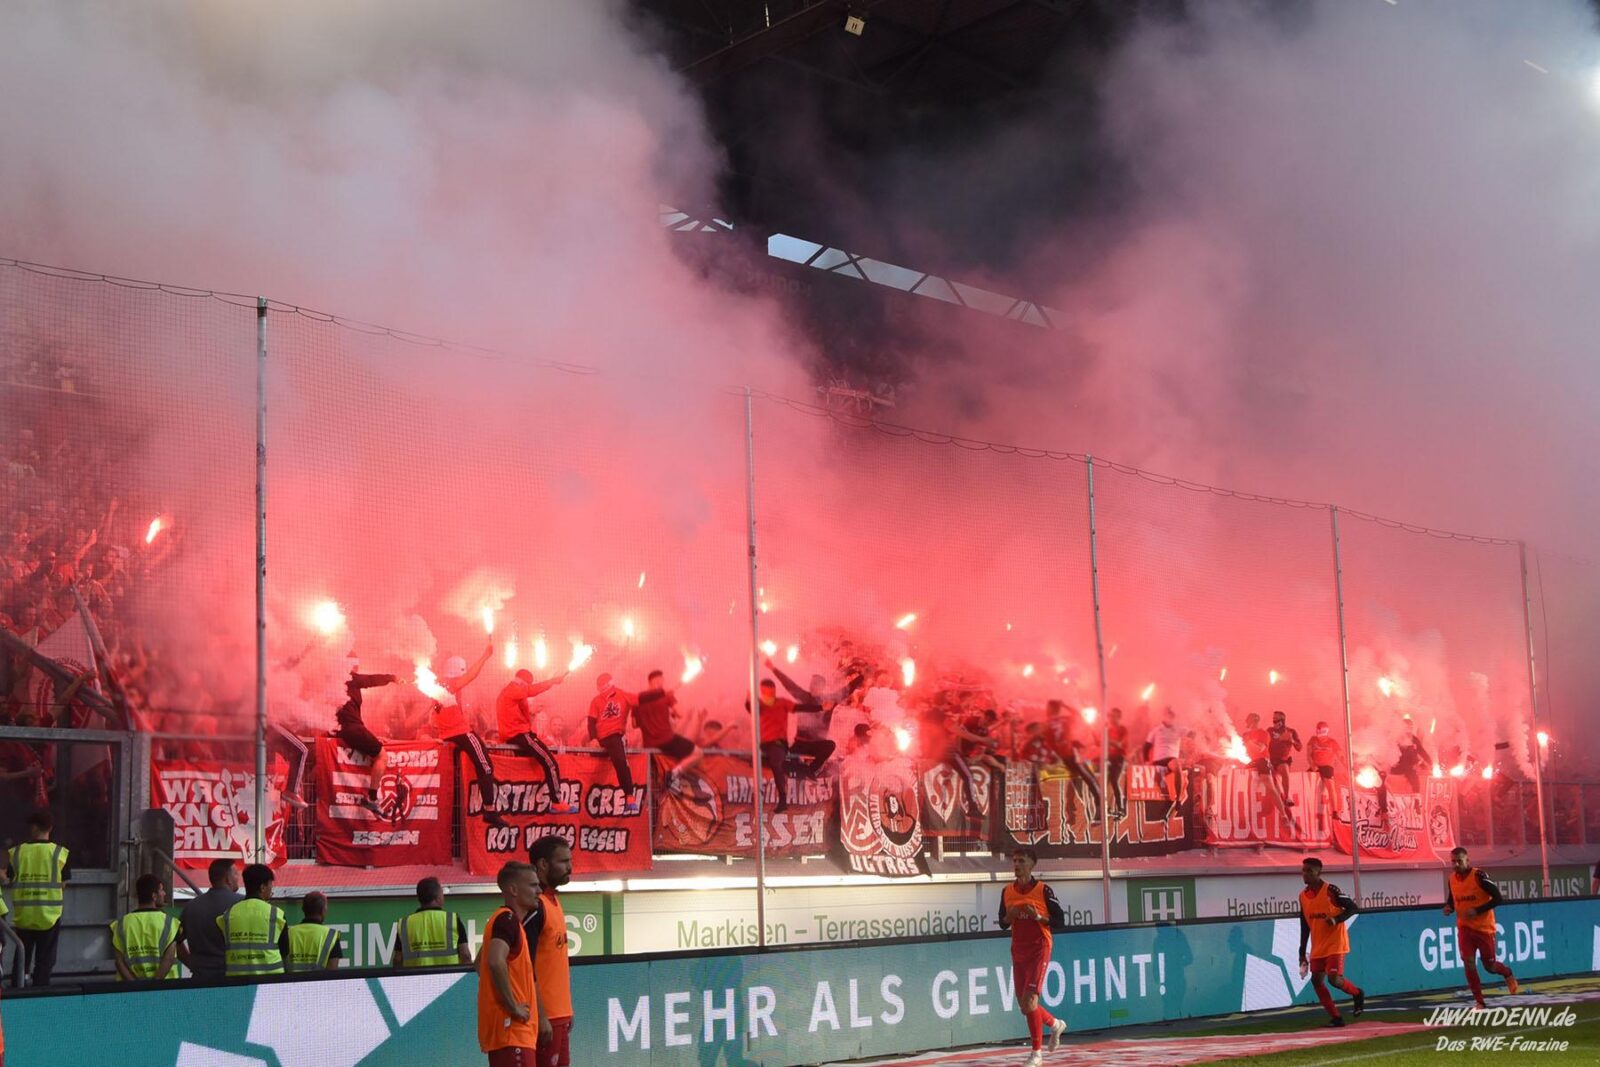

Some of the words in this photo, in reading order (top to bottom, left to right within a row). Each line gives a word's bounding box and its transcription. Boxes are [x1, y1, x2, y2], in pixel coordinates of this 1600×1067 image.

[469, 782, 582, 814] NRTHSDE
[352, 831, 420, 846] ESSEN
[487, 826, 519, 850] ROT
[580, 827, 628, 851] ESSEN
[850, 854, 920, 875] ULTRAS
[1494, 880, 1524, 900] EIM
[1227, 895, 1299, 917] Haustüren
[677, 919, 787, 947] Markisen
[814, 910, 987, 941] Terrassendächer
[324, 922, 398, 967] EIM
[1418, 919, 1547, 972] GEG.DE
[607, 985, 778, 1053] MEHR
[808, 973, 905, 1032] ALS
